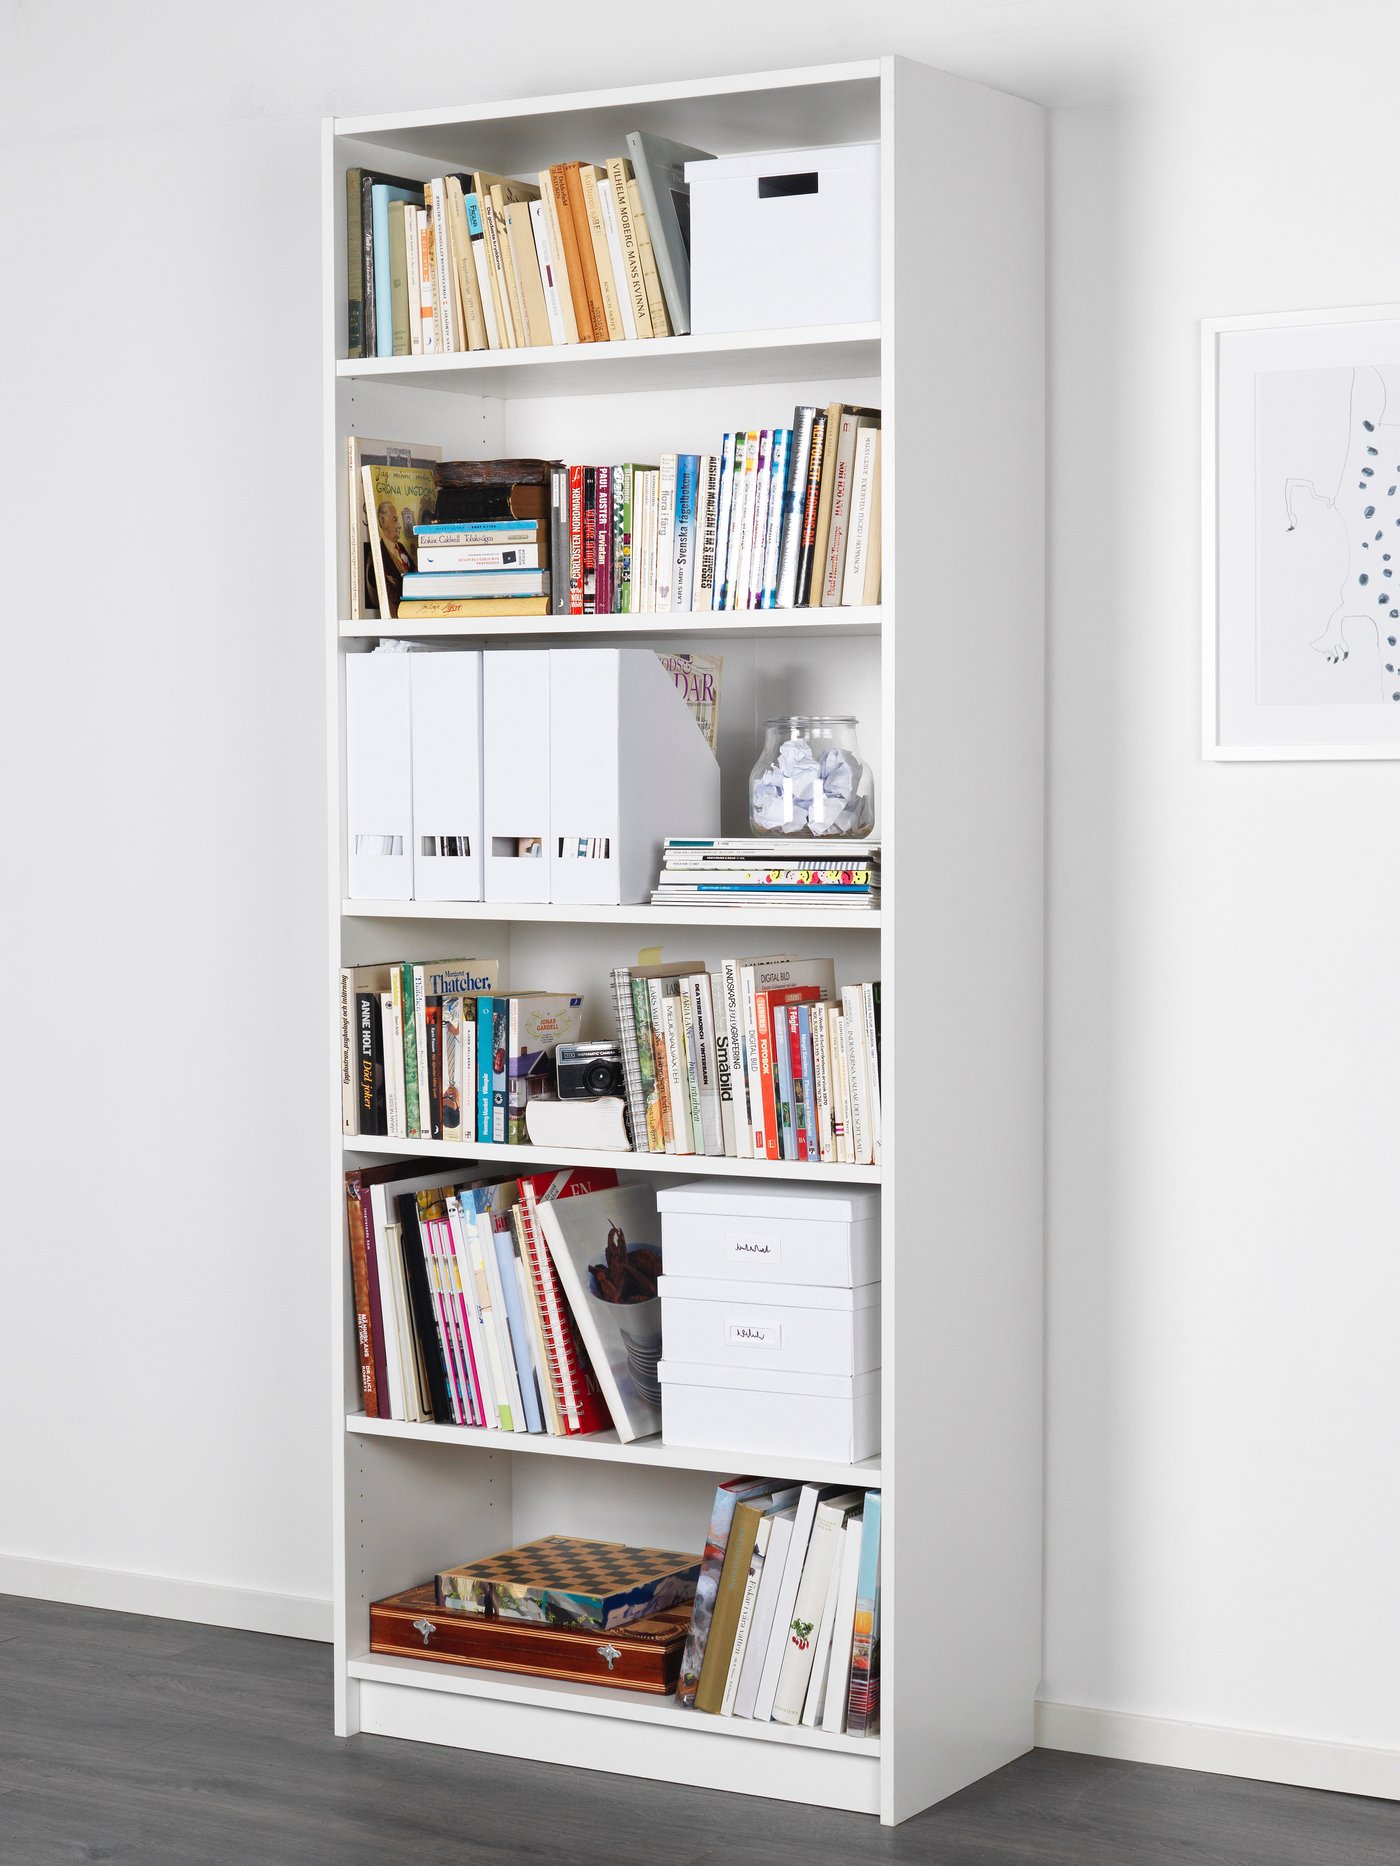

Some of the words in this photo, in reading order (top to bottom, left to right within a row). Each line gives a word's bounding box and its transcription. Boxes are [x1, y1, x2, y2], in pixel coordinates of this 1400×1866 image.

[612, 163, 626, 205] VILHELM
[619, 206, 634, 248] MOBERG
[627, 251, 639, 279] MANS
[633, 280, 646, 319] KVINNA
[814, 424, 825, 444] KEN
[863, 437, 871, 456] MARIA
[376, 467, 389, 483] Jag
[809, 444, 823, 482] FOLLETT
[838, 461, 846, 479] HON
[376, 481, 402, 495] GRÖNA
[598, 468, 608, 490] PAUL
[623, 468, 631, 505] Blommor
[836, 481, 844, 498] OCH
[571, 487, 581, 533] NORDMARK
[598, 492, 608, 525] AUSTER
[661, 490, 669, 512] flora
[678, 472, 691, 524] fågelboken
[804, 484, 819, 528] LEJONENS
[835, 499, 843, 517] HAN
[659, 517, 669, 536] färg
[802, 530, 814, 547] DAL
[597, 530, 607, 565] Leviatan
[676, 526, 688, 565] Svenska
[341, 974, 349, 1005] inlärning
[429, 971, 491, 994] Thatcher,
[760, 972, 780, 984] DIGITAL
[780, 971, 791, 981] BILD
[649, 985, 658, 1005] LARS
[682, 990, 690, 1016] MARIA
[361, 1000, 371, 1029] ANNE
[652, 1007, 661, 1047] WIDDING
[683, 1016, 692, 1039] LANG
[789, 1011, 799, 1034] Fåglar
[342, 1018, 350, 1049] psykologi
[361, 1030, 372, 1057] HOLT
[748, 1030, 757, 1056] DIGITAL
[801, 1034, 809, 1053] Margit
[700, 1043, 709, 1085] VINTERBARN
[750, 1057, 758, 1072] BILD
[760, 1039, 770, 1075] FOTOBOK
[847, 1030, 858, 1076] INDIANERNA
[362, 1060, 373, 1081] Död
[716, 1036, 733, 1102] Småbild
[360, 1084, 373, 1110] joker
[851, 1076, 860, 1102] KALLAR
[855, 1118, 863, 1137] SÖTT
[570, 1181, 592, 1197] EN
[365, 1365, 371, 1374] DR
[744, 1579, 757, 1607] Fiskar
[739, 1611, 751, 1629] våra
[734, 1629, 747, 1655] vatten
